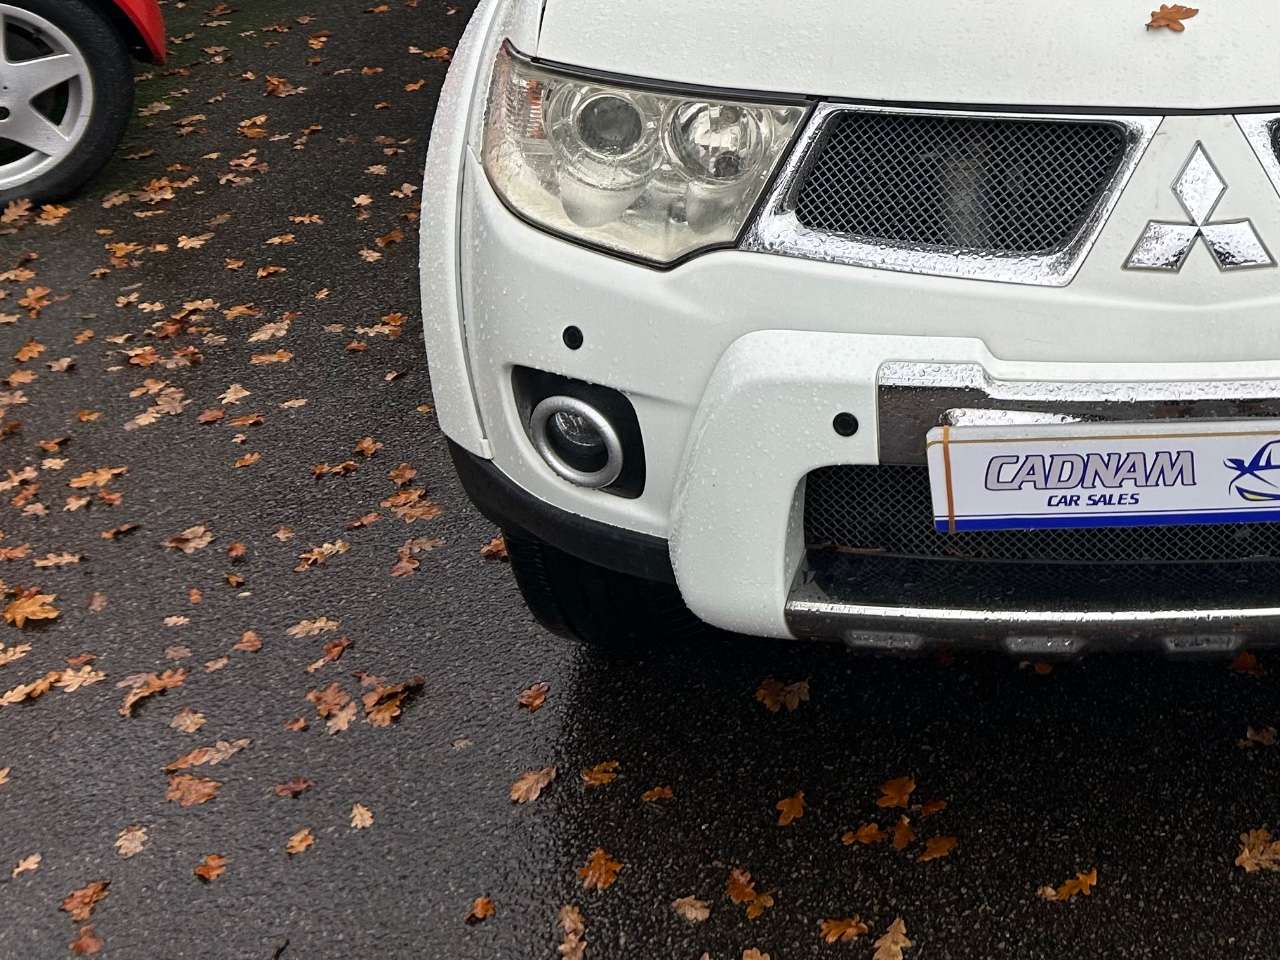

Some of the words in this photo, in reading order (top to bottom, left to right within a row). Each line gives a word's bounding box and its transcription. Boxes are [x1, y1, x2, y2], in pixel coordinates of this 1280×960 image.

[985, 450, 1197, 491] CADNAM
[1047, 495, 1081, 507] CAR
[1086, 493, 1140, 507] SALES
